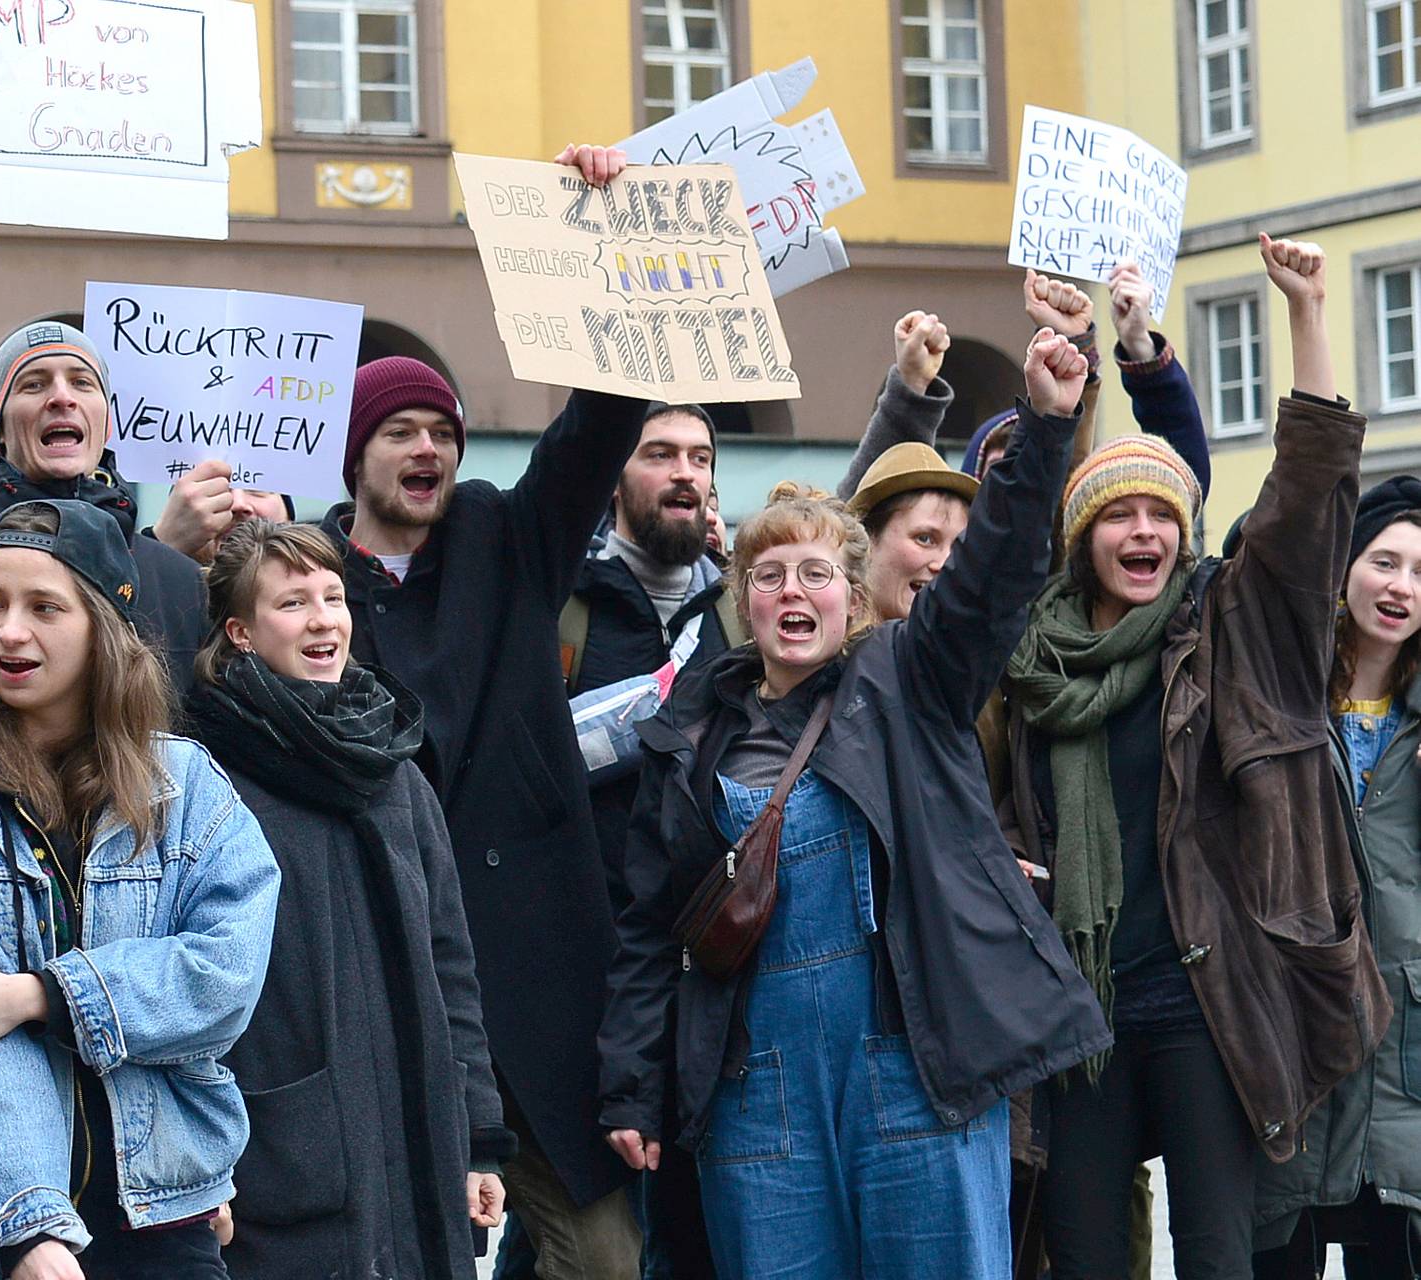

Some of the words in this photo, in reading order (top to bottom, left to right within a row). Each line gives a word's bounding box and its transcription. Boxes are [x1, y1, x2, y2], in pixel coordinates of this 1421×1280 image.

[94, 24, 150, 45] von
[28, 102, 173, 156] Gnaden
[1031, 119, 1113, 163] EINE
[1028, 153, 1083, 183] DIE
[1098, 169, 1128, 195] IN
[484, 181, 549, 219] DER
[557, 175, 749, 239] ZWECK
[1019, 219, 1090, 251] RICHT
[1022, 247, 1083, 273] HAT
[105, 297, 334, 363] RÜCKTRITT
[203, 365, 234, 390] &
[252, 376, 336, 404] AFDP
[110, 392, 326, 456] NEUWAHLEN
